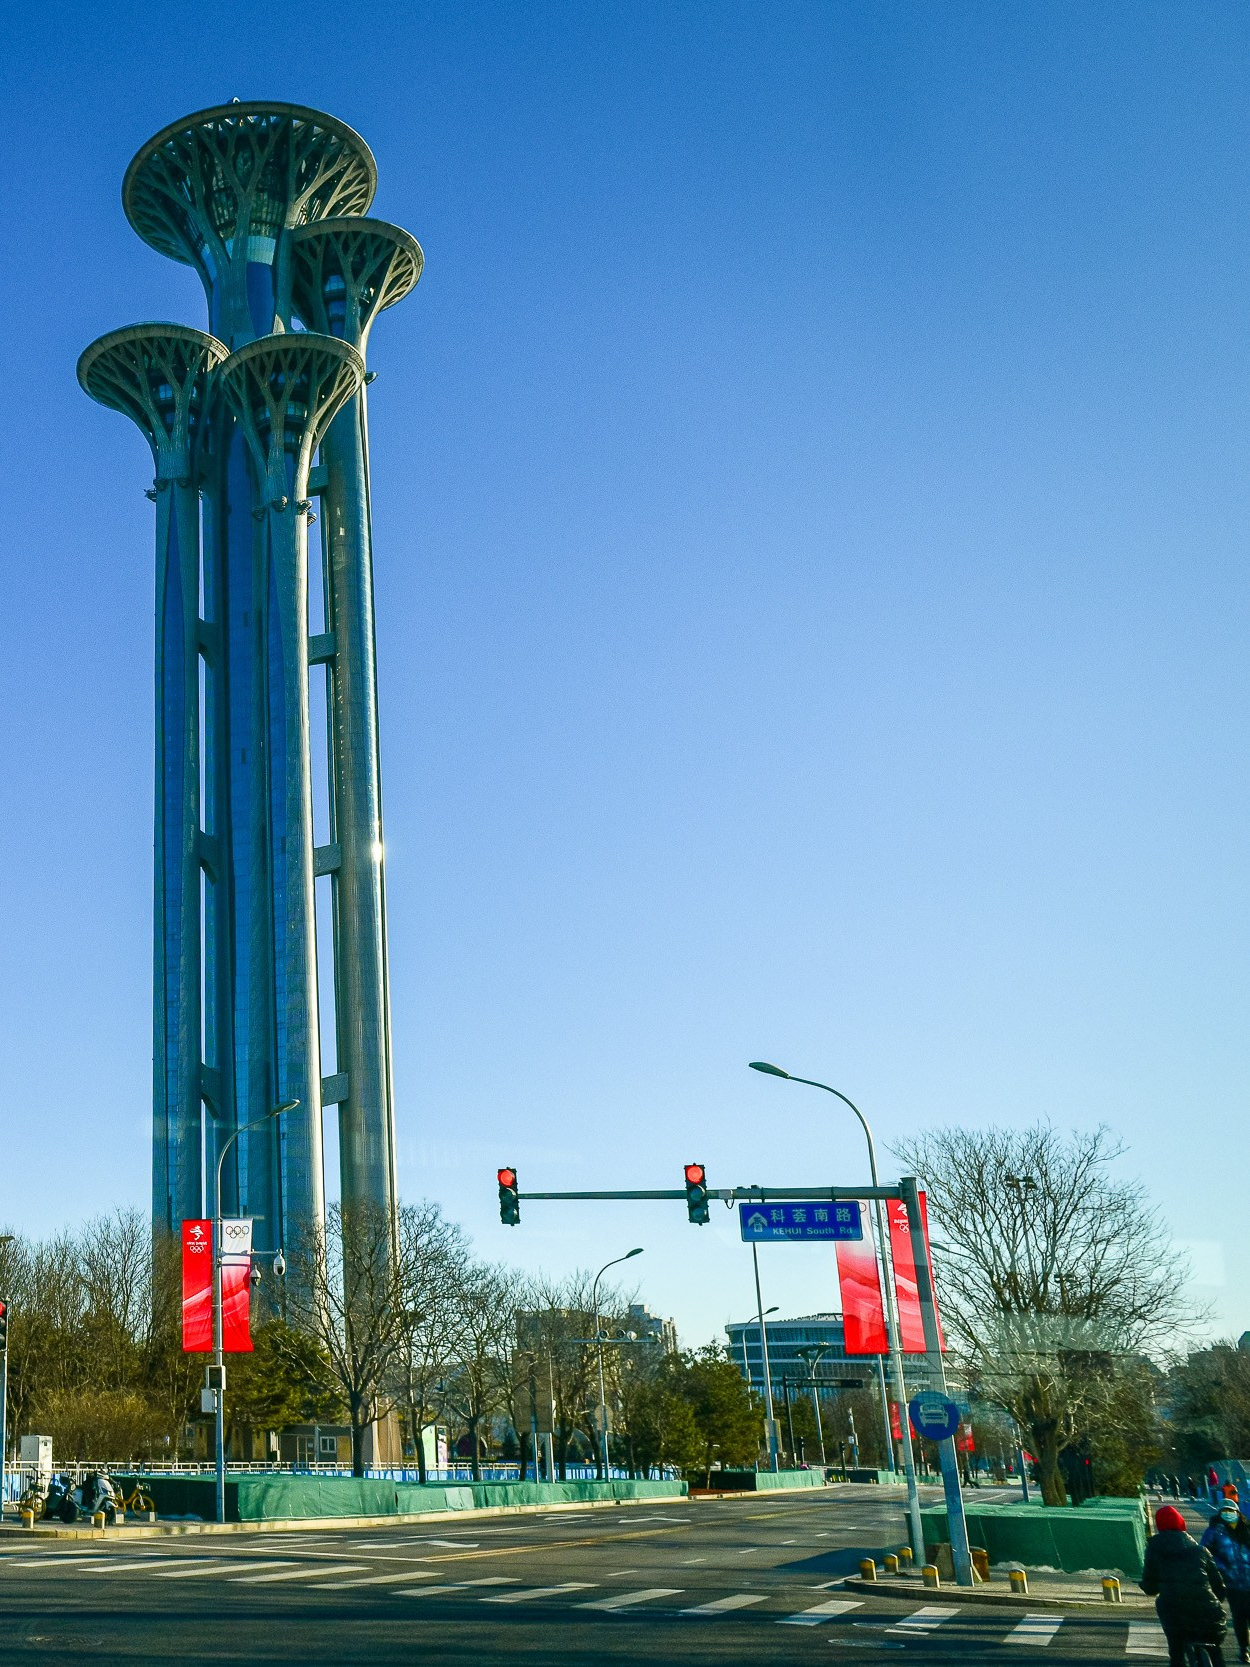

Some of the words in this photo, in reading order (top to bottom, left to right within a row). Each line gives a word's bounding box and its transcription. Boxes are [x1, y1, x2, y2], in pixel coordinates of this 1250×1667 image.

[770, 1208, 851, 1223] 科荟南路
[772, 1227, 802, 1235] KEHUI
[806, 1227, 835, 1235] South
[839, 1226, 853, 1235] Rd
